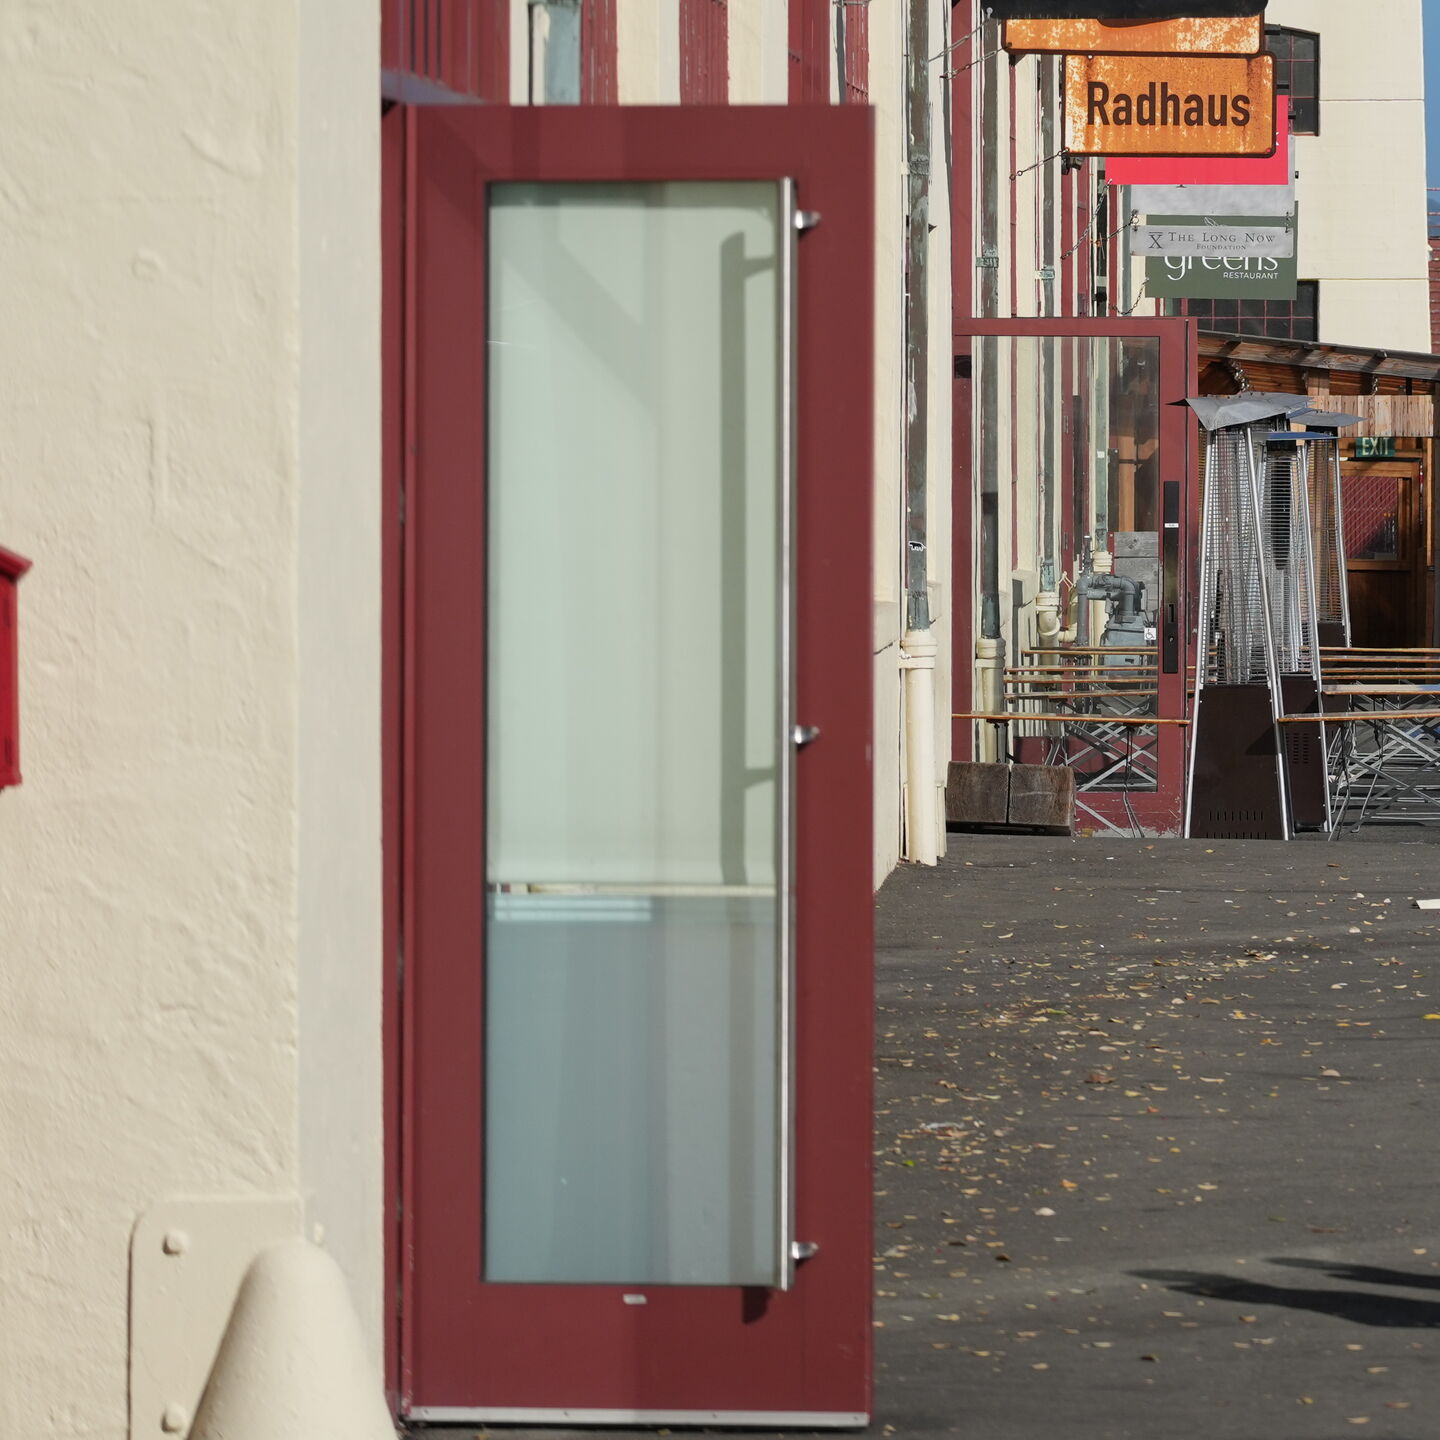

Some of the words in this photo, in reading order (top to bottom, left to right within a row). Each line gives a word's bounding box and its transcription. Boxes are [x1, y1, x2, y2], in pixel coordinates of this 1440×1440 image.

[1087, 81, 1250, 127] Radhaus
[1223, 271, 1278, 280] RESTAURANT
[1362, 437, 1390, 456] EXIT
